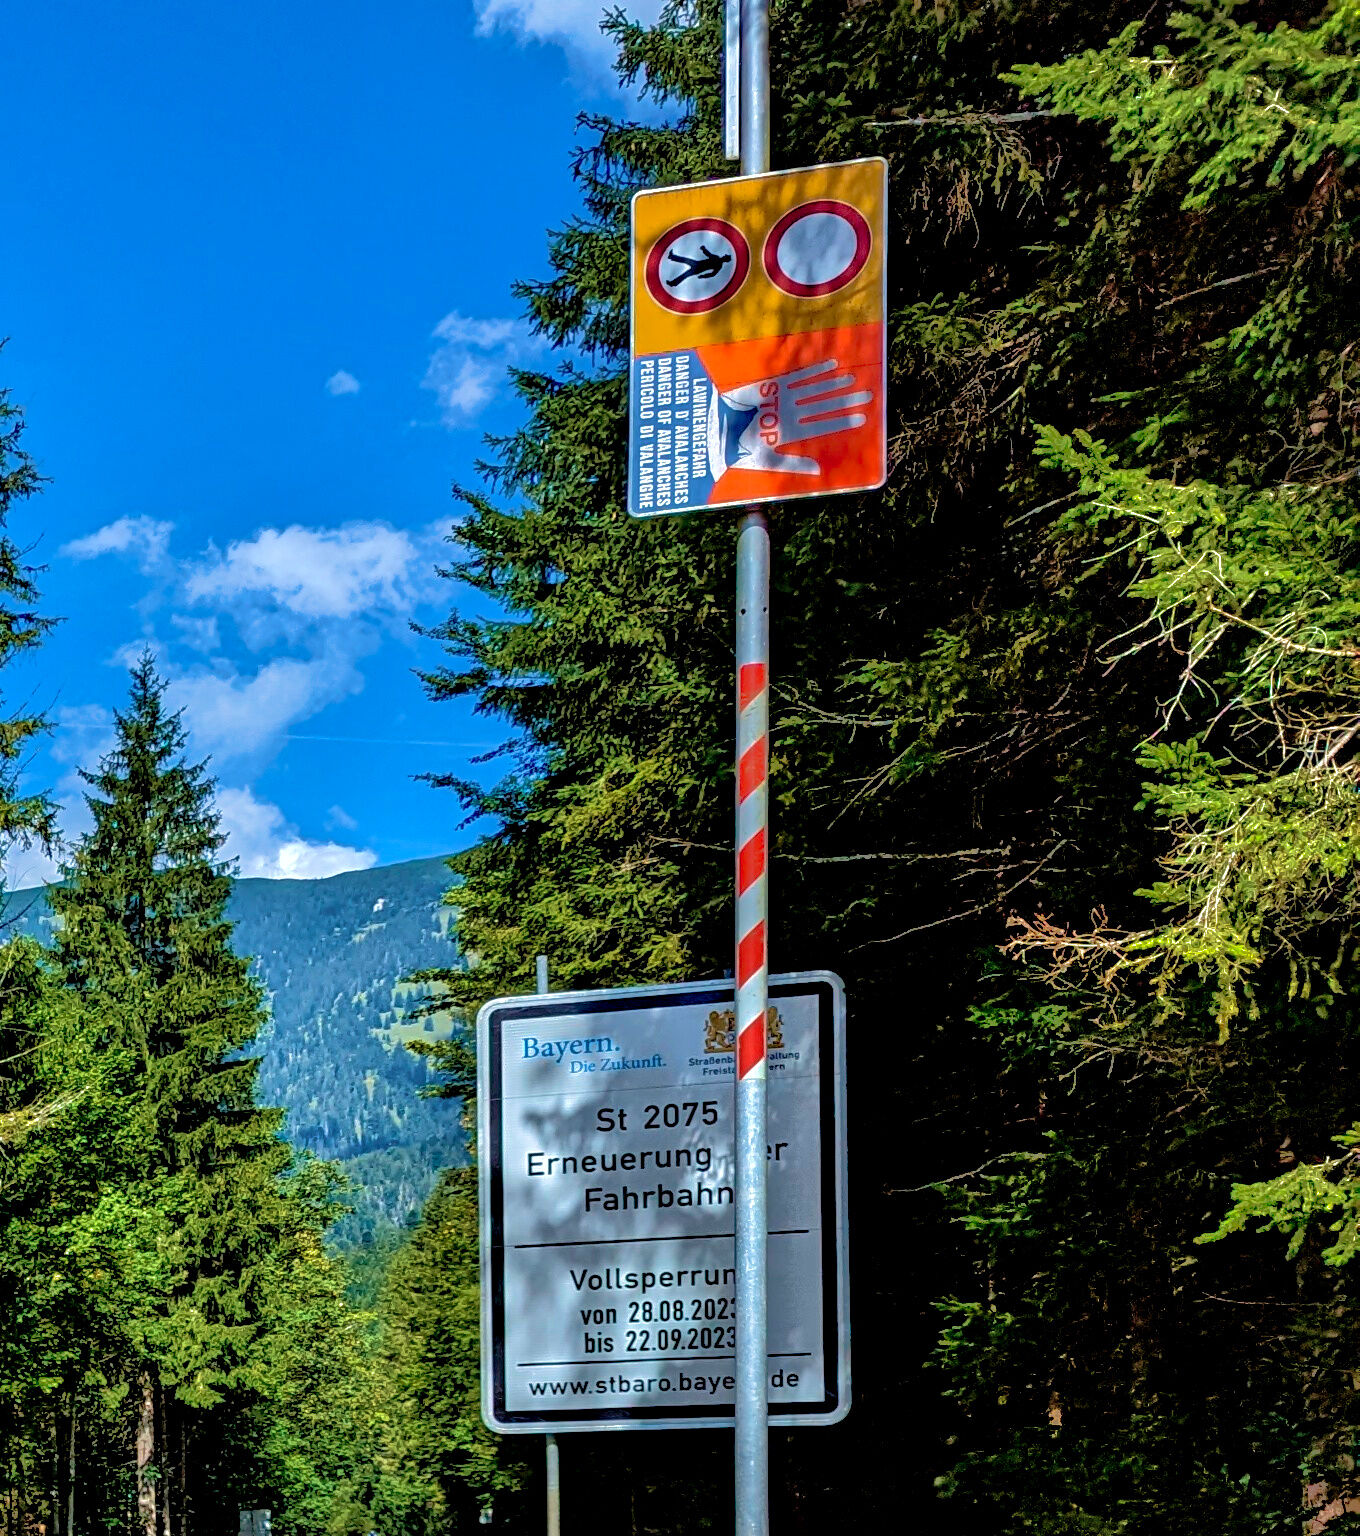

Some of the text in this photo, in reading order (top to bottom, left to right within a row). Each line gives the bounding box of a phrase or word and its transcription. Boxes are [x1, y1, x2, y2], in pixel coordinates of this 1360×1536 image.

[675, 355, 689, 405] DANGER
[692, 377, 707, 479] LAWINENGEFAHR
[760, 382, 779, 446] STOP
[639, 360, 655, 509] PERICOLO DI VALANGHE
[656, 357, 672, 507] DANGER OF AVALANCHES
[674, 425, 689, 504] AVALANCHES
[521, 1036, 621, 1064] Bayern.
[570, 1054, 667, 1074] Die Zukunft.
[596, 1100, 719, 1132] St 2075
[527, 1147, 712, 1176] Erneuerung
[585, 1183, 734, 1212] Fahrbahn
[570, 1268, 736, 1294] Vollsperrun
[580, 1307, 617, 1325] von
[584, 1327, 736, 1354] bis 22.09.2023
[529, 1369, 799, 1396] www.stbaro.bayede
